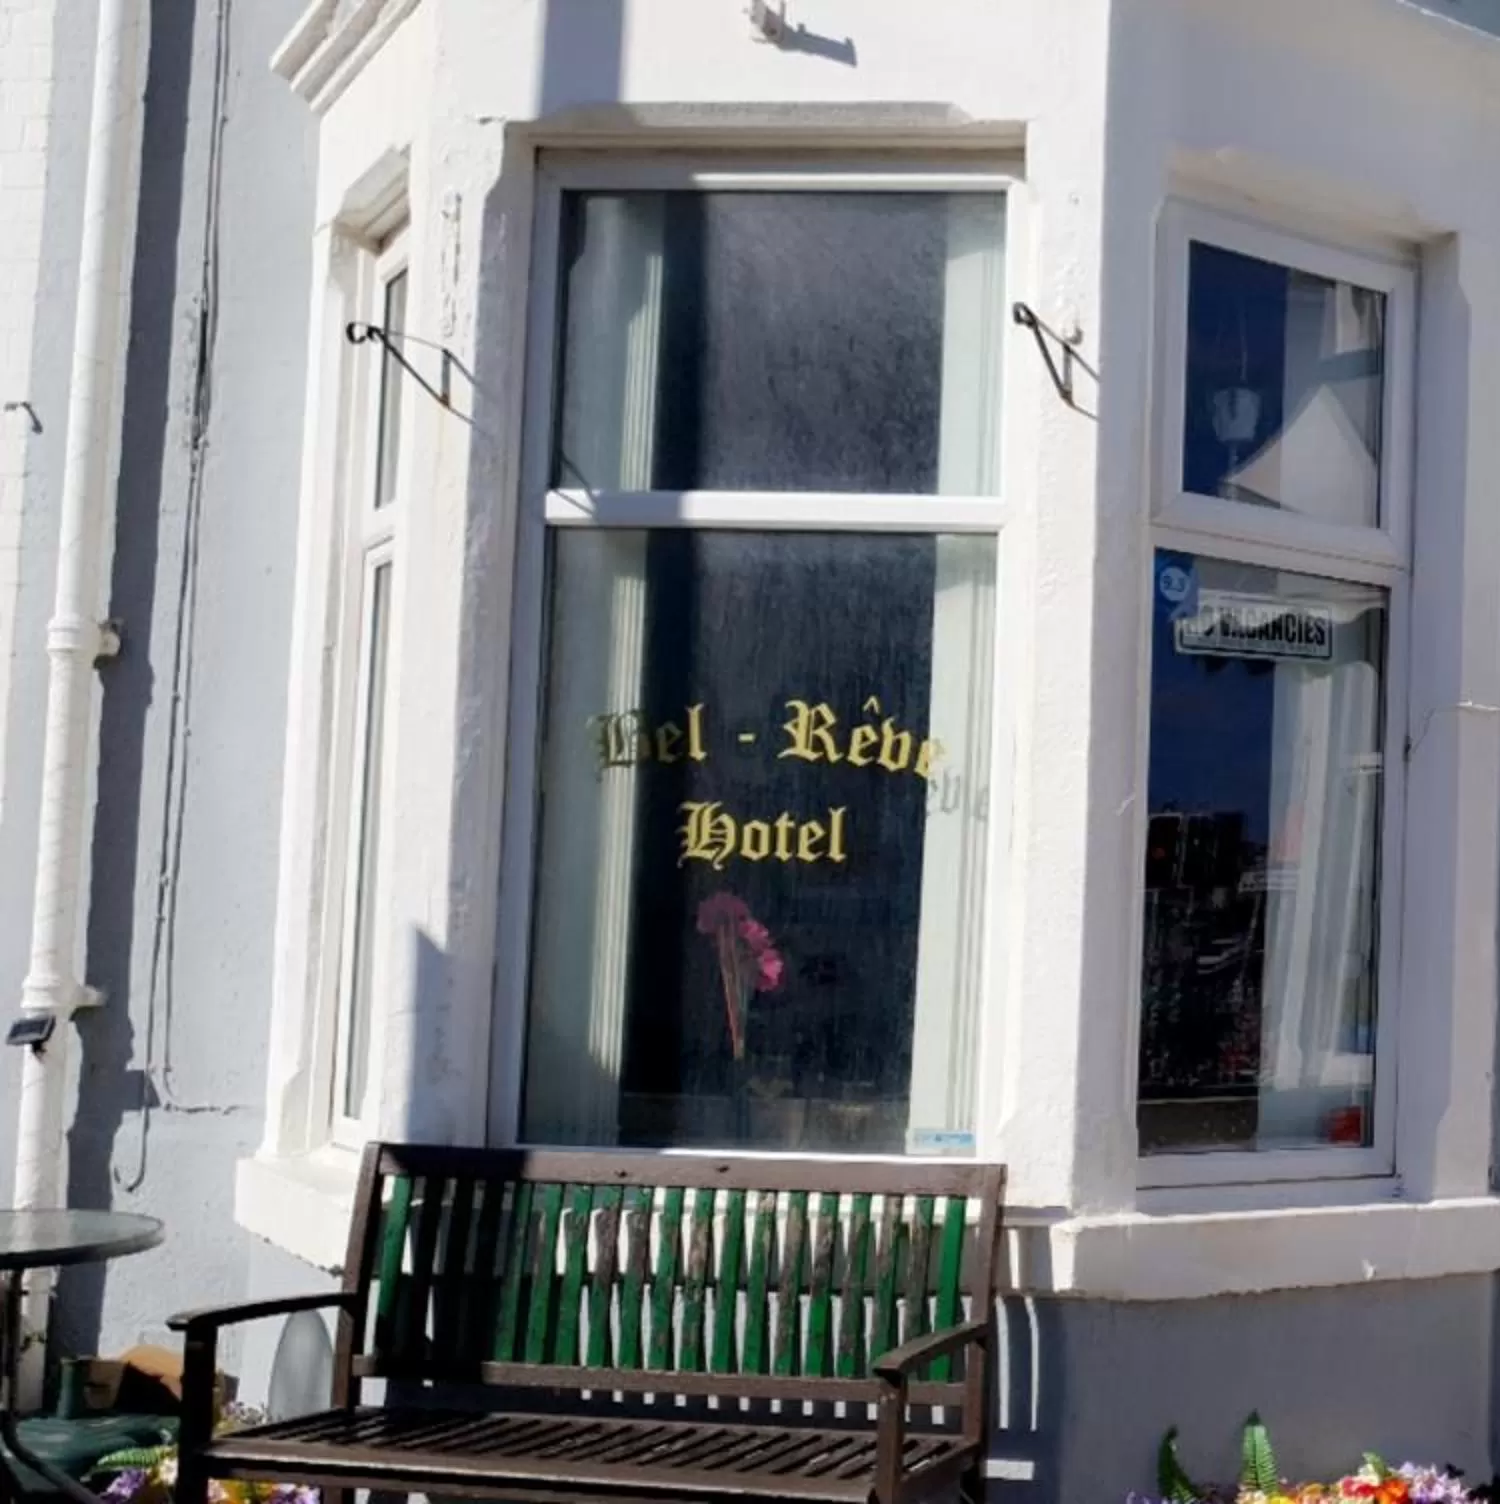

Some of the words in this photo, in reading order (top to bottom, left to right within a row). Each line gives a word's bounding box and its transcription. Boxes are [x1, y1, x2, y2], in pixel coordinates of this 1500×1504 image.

[1218, 607, 1327, 646] VACANCIES
[586, 702, 708, 783] Bel
[738, 731, 756, 744] -
[777, 695, 947, 779] Rêve
[676, 800, 846, 870] Hotel
